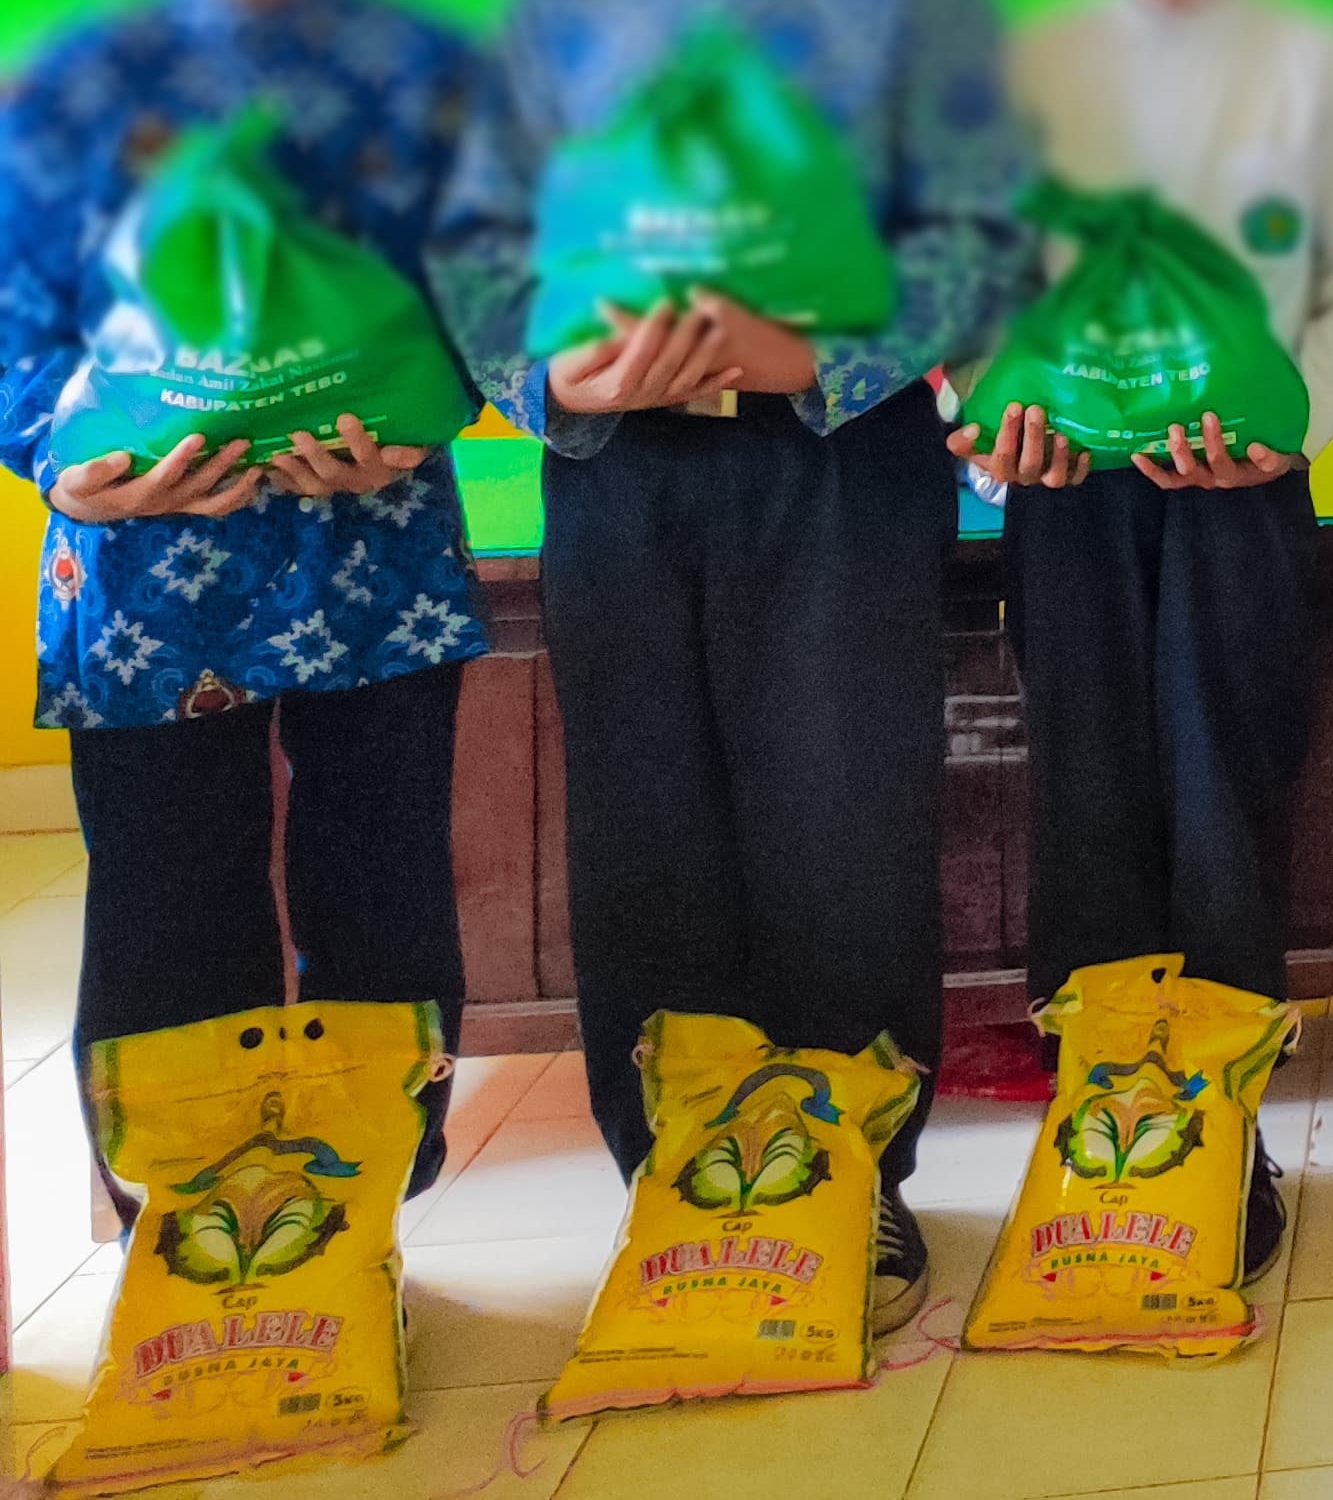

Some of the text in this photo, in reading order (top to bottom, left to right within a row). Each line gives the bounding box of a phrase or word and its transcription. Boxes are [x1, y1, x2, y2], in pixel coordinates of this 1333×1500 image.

[1166, 361, 1211, 382] TEBO
[160, 370, 348, 413] KABUPATEN TEBO
[1099, 1192, 1128, 1206] Cap
[722, 1220, 753, 1234] Cap
[221, 1294, 258, 1310] Cap
